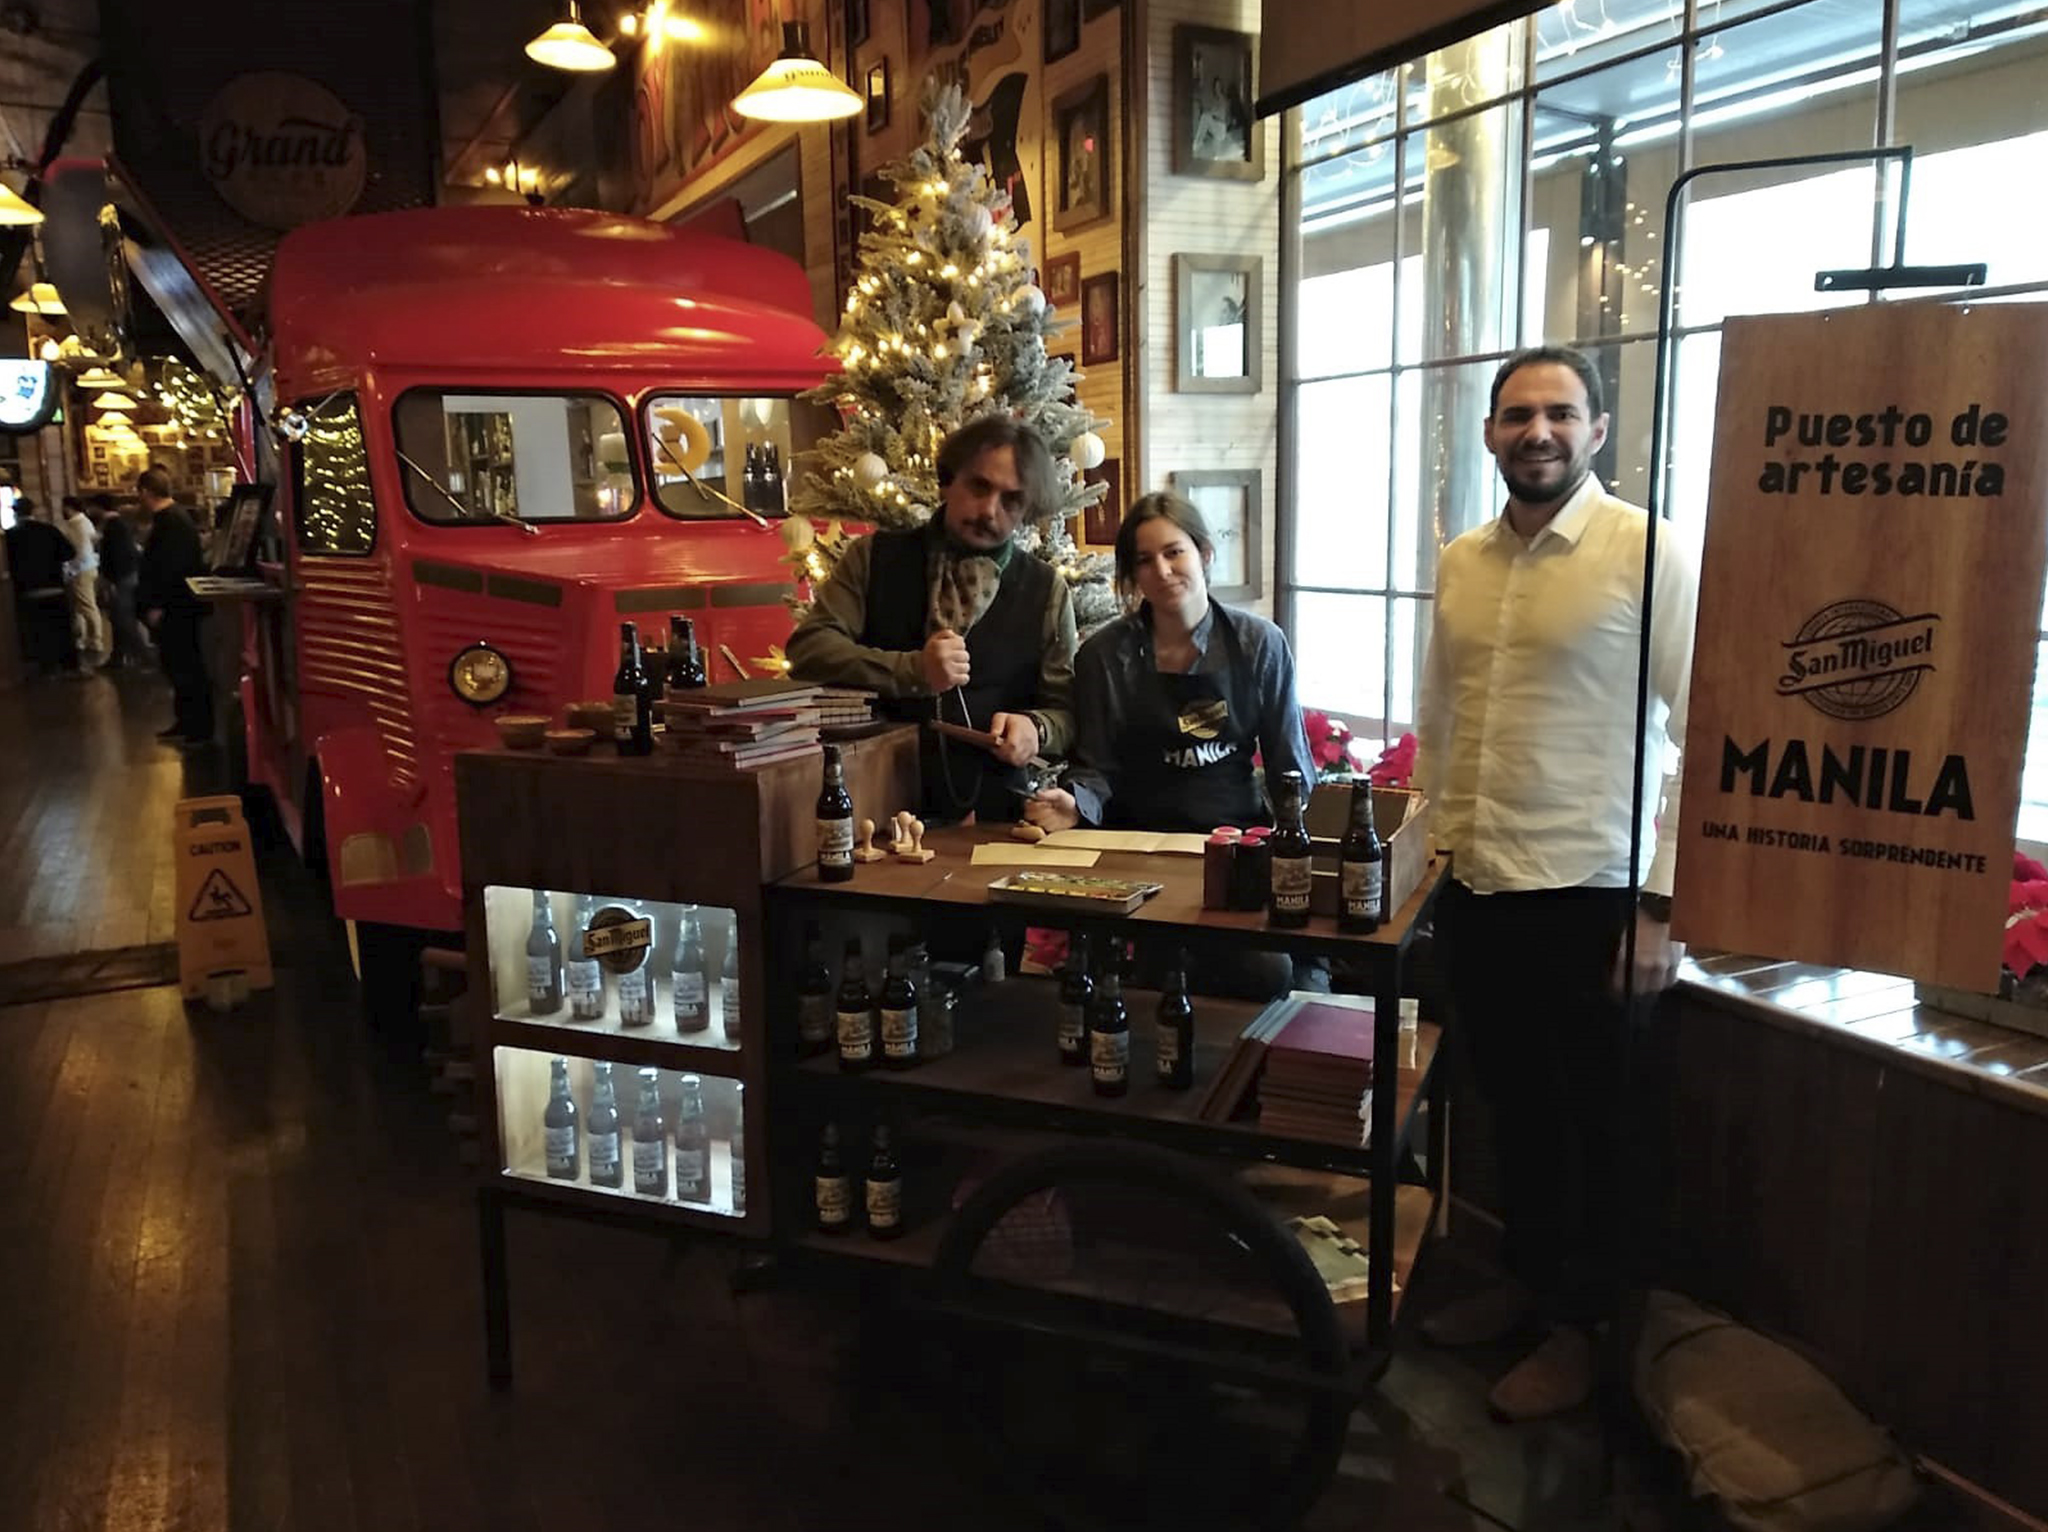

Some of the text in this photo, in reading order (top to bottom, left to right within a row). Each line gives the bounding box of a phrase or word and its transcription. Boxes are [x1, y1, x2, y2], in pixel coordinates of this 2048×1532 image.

[207, 115, 354, 180] Grand
[1764, 404, 2009, 448] Puesto de
[1758, 454, 2007, 498] artesanía
[1719, 735, 1975, 822] MANILA
[1701, 820, 1988, 875] UNA HISTORIA SORPRENDENTE
